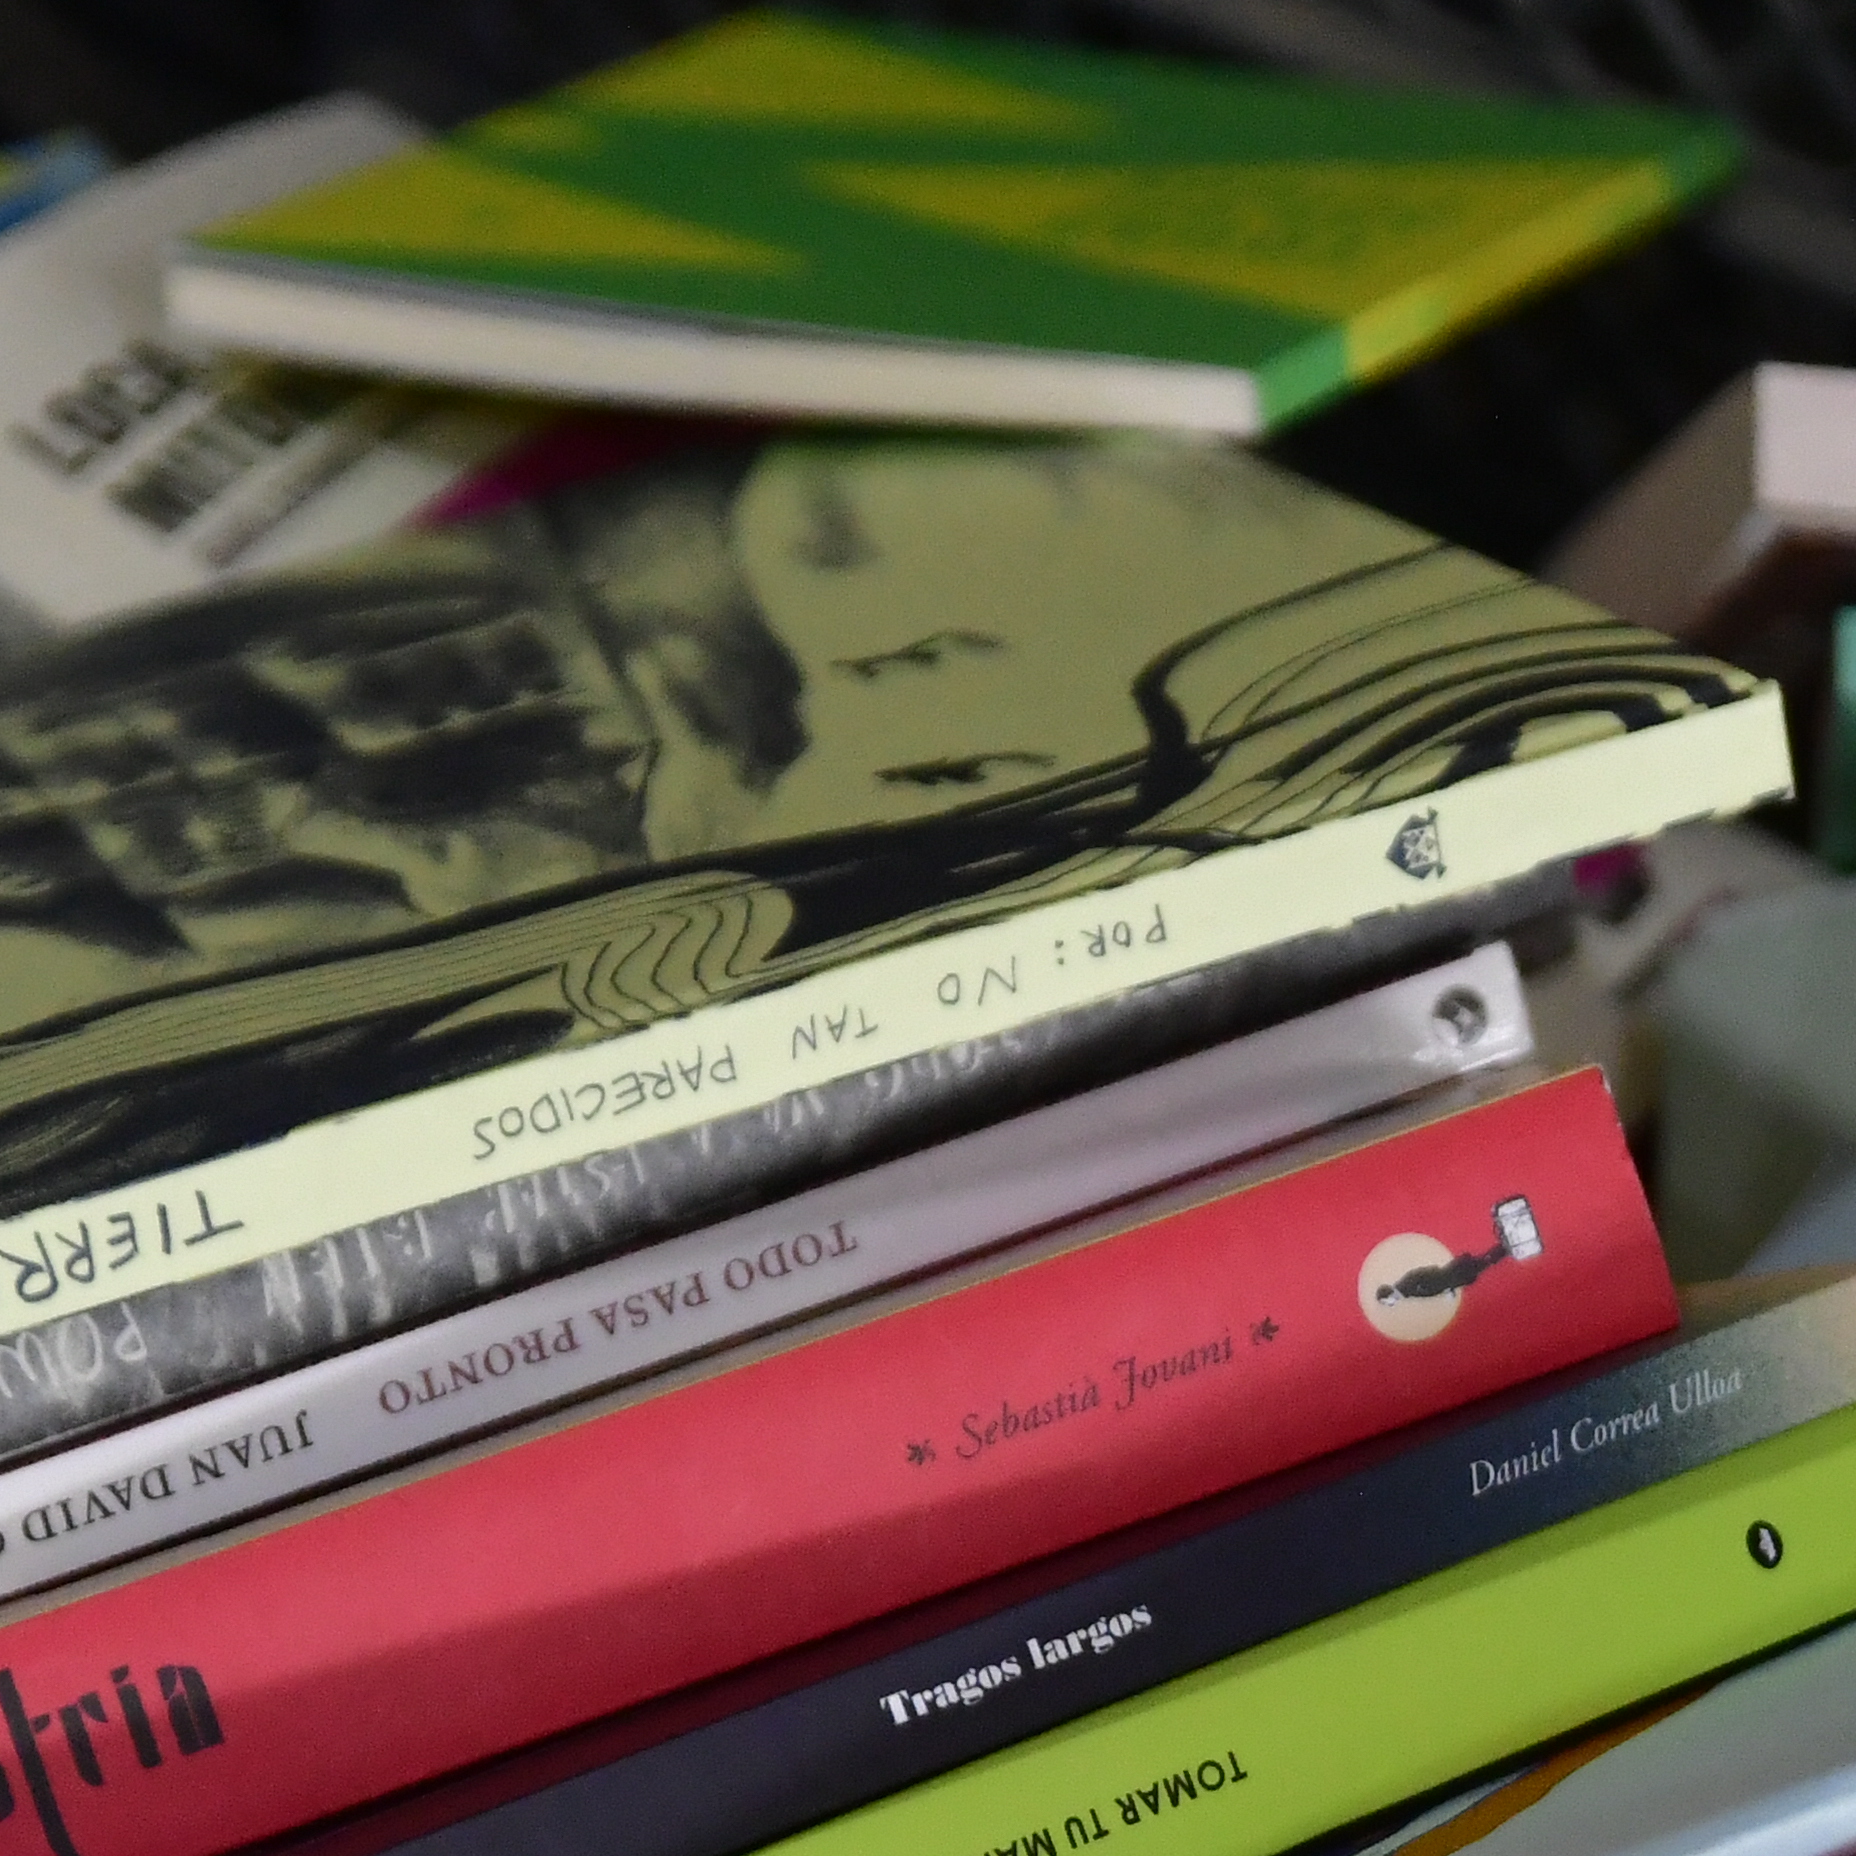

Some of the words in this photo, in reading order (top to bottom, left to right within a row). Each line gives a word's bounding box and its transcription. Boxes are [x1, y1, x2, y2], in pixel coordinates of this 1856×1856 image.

[925, 947, 1031, 1022] NO
[778, 991, 886, 1064] TAN
[473, 1045, 737, 1161] PARECIDOS
[724, 1220, 858, 1291] TODO
[591, 1273, 710, 1336] PASA
[379, 1319, 580, 1414] PRONTO
[190, 1411, 313, 1486] JUAN
[1470, 1429, 1561, 1496] Daniel
[1560, 1385, 1665, 1461] Correa
[1657, 1350, 1750, 1421] Ulloa
[10, 1465, 175, 1542] DAVID
[880, 1657, 1021, 1725] Tragos
[1027, 1606, 1152, 1669] largos
[1115, 1752, 1247, 1825] TOMAR
[1057, 1801, 1112, 1853] TU
